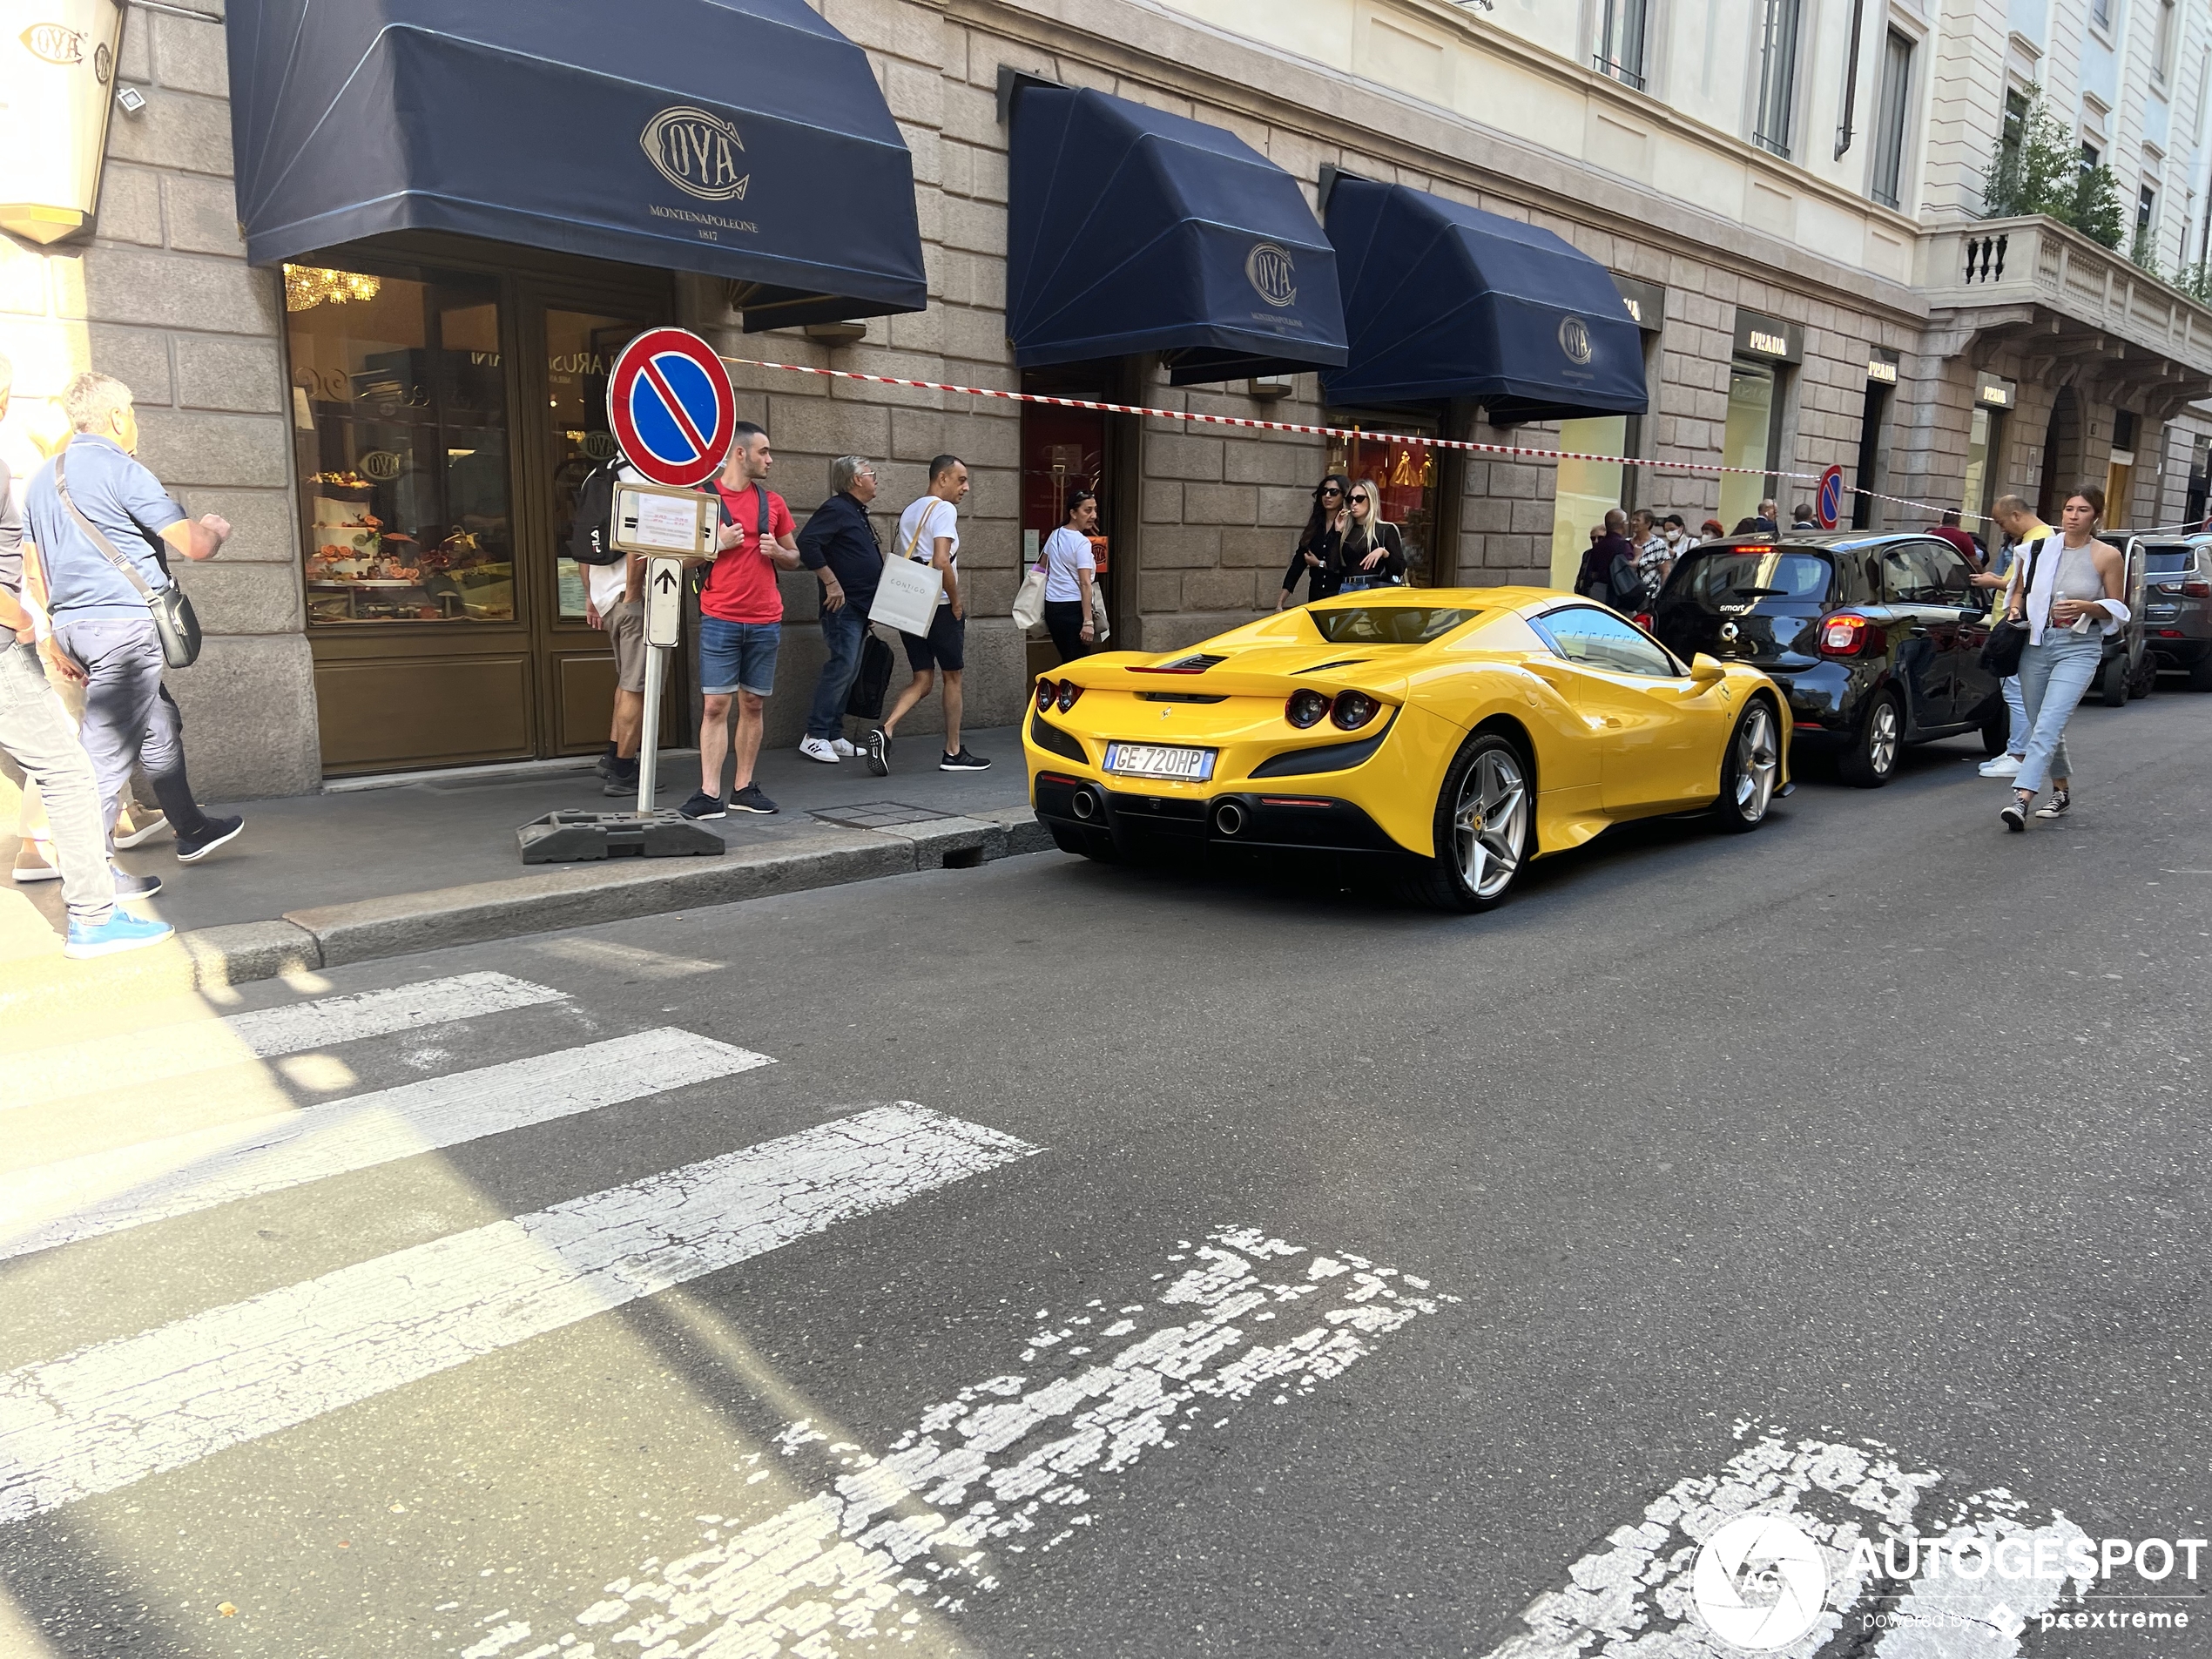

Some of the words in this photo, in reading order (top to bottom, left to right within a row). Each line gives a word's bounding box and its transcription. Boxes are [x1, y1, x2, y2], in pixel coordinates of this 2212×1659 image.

[649, 204, 759, 233] MONTENAPOLEONE
[698, 229, 718, 240] 1817
[1750, 331, 1787, 356] PRADA
[1868, 361, 1897, 381] PRADA
[1983, 386, 2006, 404] PRADA
[590, 529, 602, 554] FILA
[890, 578, 925, 595] CONTIGO
[1116, 746, 1140, 769] GE
[1142, 748, 1201, 774] 720HP
